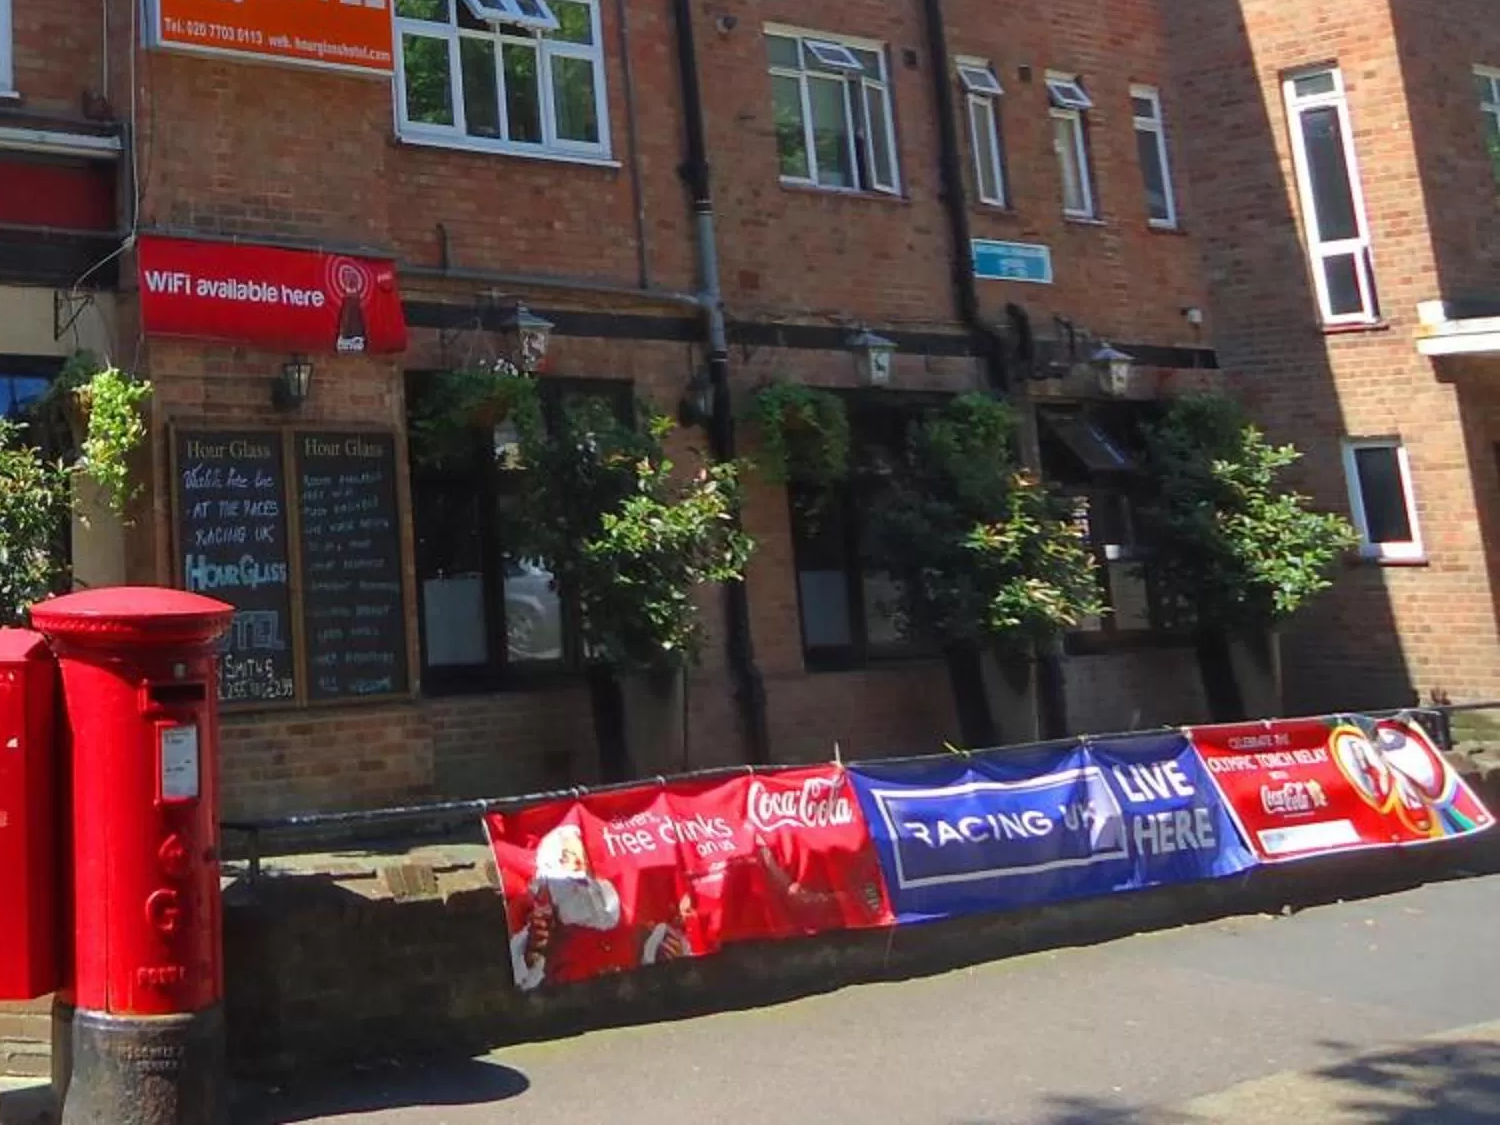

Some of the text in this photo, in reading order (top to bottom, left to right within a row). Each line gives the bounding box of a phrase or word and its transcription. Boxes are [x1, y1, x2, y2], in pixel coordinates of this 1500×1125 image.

[144, 270, 325, 308] WiFi available here
[186, 438, 272, 459] Hour Glass
[304, 437, 340, 457] Hour
[196, 523, 274, 546] RACING UK
[1207, 747, 1329, 773] OLYMPIC TORCH RELAY
[1114, 759, 1194, 803] LIVE
[747, 777, 854, 832] Coca-Cola
[903, 810, 1053, 848] RACING
[1133, 807, 1216, 856] HERE
[696, 840, 719, 858] on
